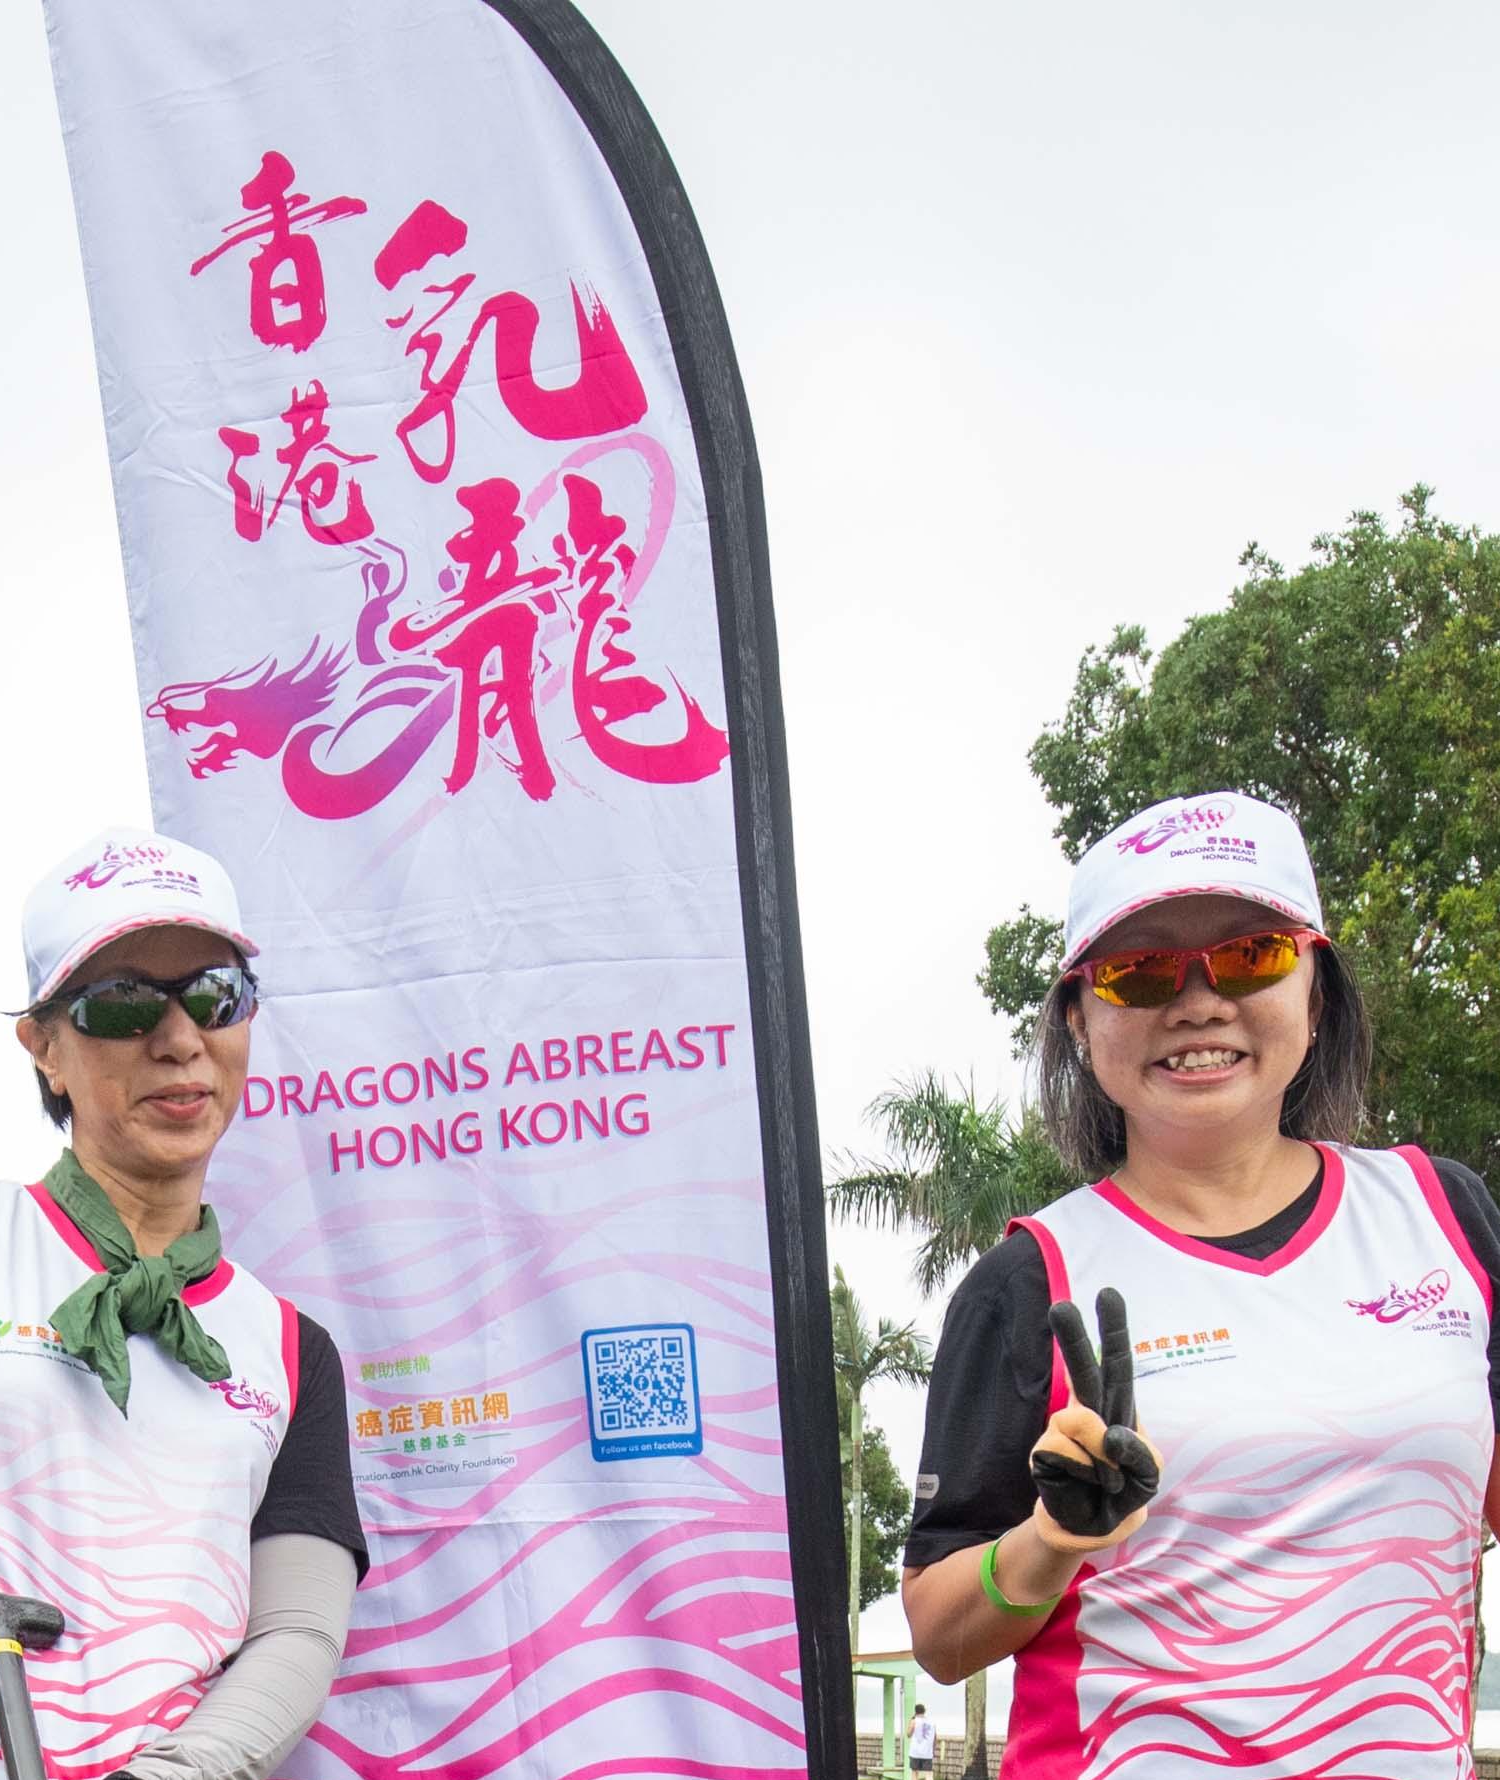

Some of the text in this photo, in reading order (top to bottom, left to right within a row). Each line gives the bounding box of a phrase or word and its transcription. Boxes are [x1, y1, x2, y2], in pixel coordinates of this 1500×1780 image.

[190, 150, 377, 546] 香港
[1170, 846, 1215, 858] DRAGONS
[1232, 854, 1257, 865] KONG
[242, 1023, 736, 1120] DRAGONS ABREAST
[328, 1092, 652, 1174] HONG KONG
[356, 1391, 510, 1438] 癌症資訊網
[640, 1443, 652, 1451] on
[653, 1440, 693, 1450] facebook
[353, 1455, 515, 1483] mation.com.hk Charity Foundation
